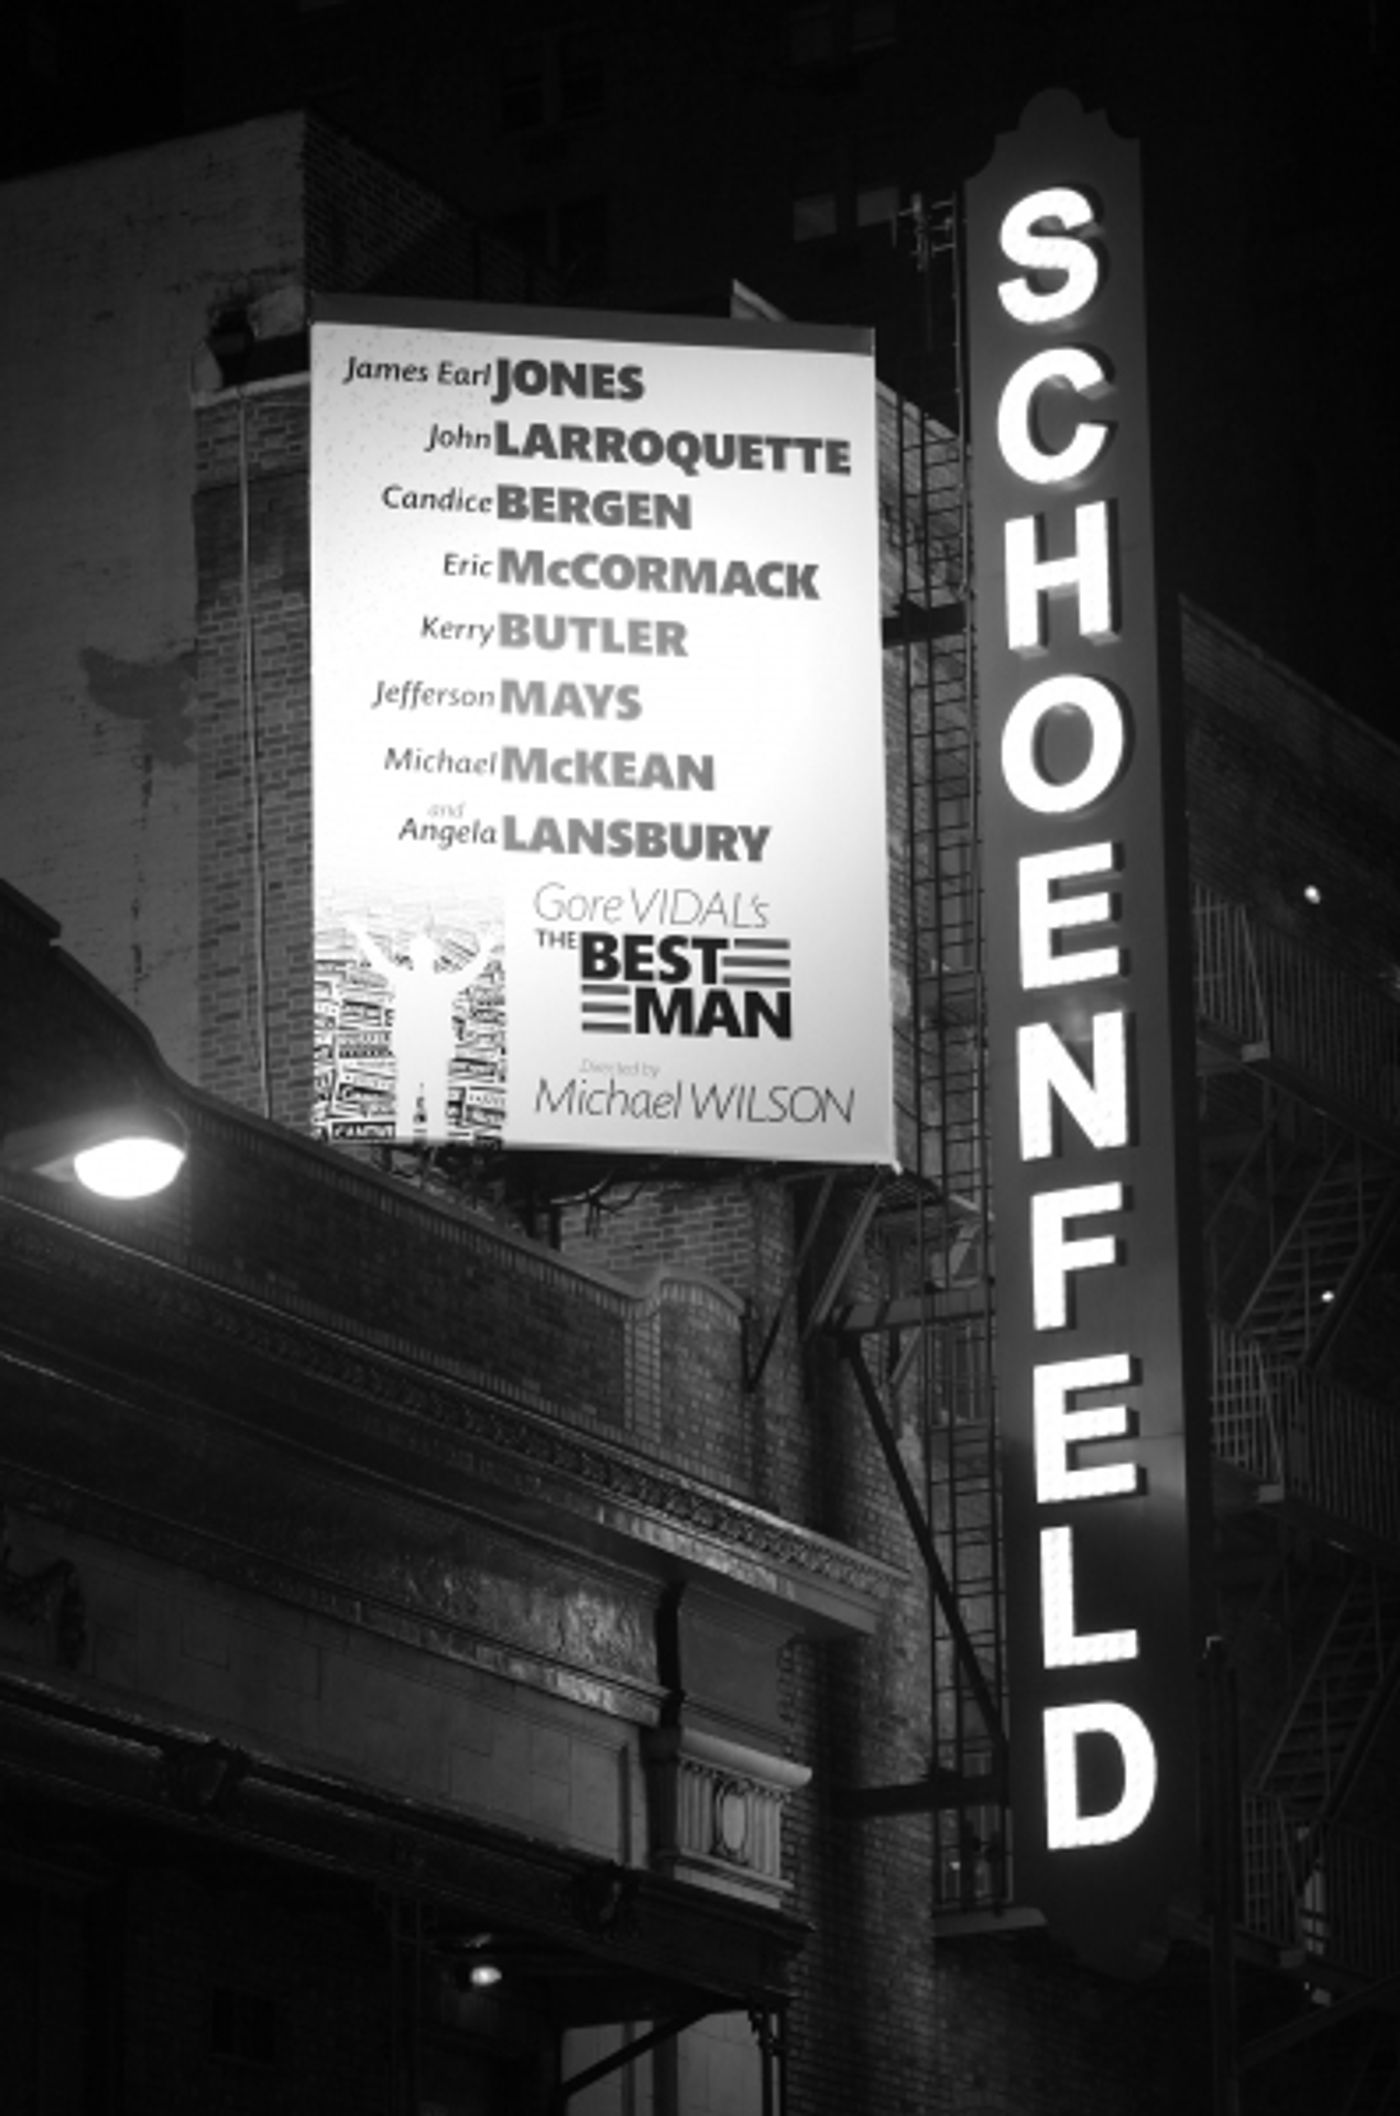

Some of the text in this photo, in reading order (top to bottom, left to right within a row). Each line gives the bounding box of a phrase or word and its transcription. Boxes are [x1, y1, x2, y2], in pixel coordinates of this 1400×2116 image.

[343, 356, 645, 404] James Earl JONES
[425, 421, 851, 476] John LARROQUETTE
[382, 484, 692, 530] Candice BERGEN
[443, 548, 822, 600] Eric McCORMACK
[420, 612, 689, 657] Kerry BUTLER
[370, 679, 643, 721] Jefferson MAYS
[384, 746, 716, 791] Michael McKEAN
[427, 802, 465, 819] and
[398, 815, 773, 862] Angela LANSBURY
[533, 881, 625, 923] Gore
[535, 929, 728, 986] THE BEST
[634, 987, 792, 1040] MAN
[996, 187, 1158, 1850] SCHOENFELD
[535, 1077, 855, 1124] Michael WILSON
